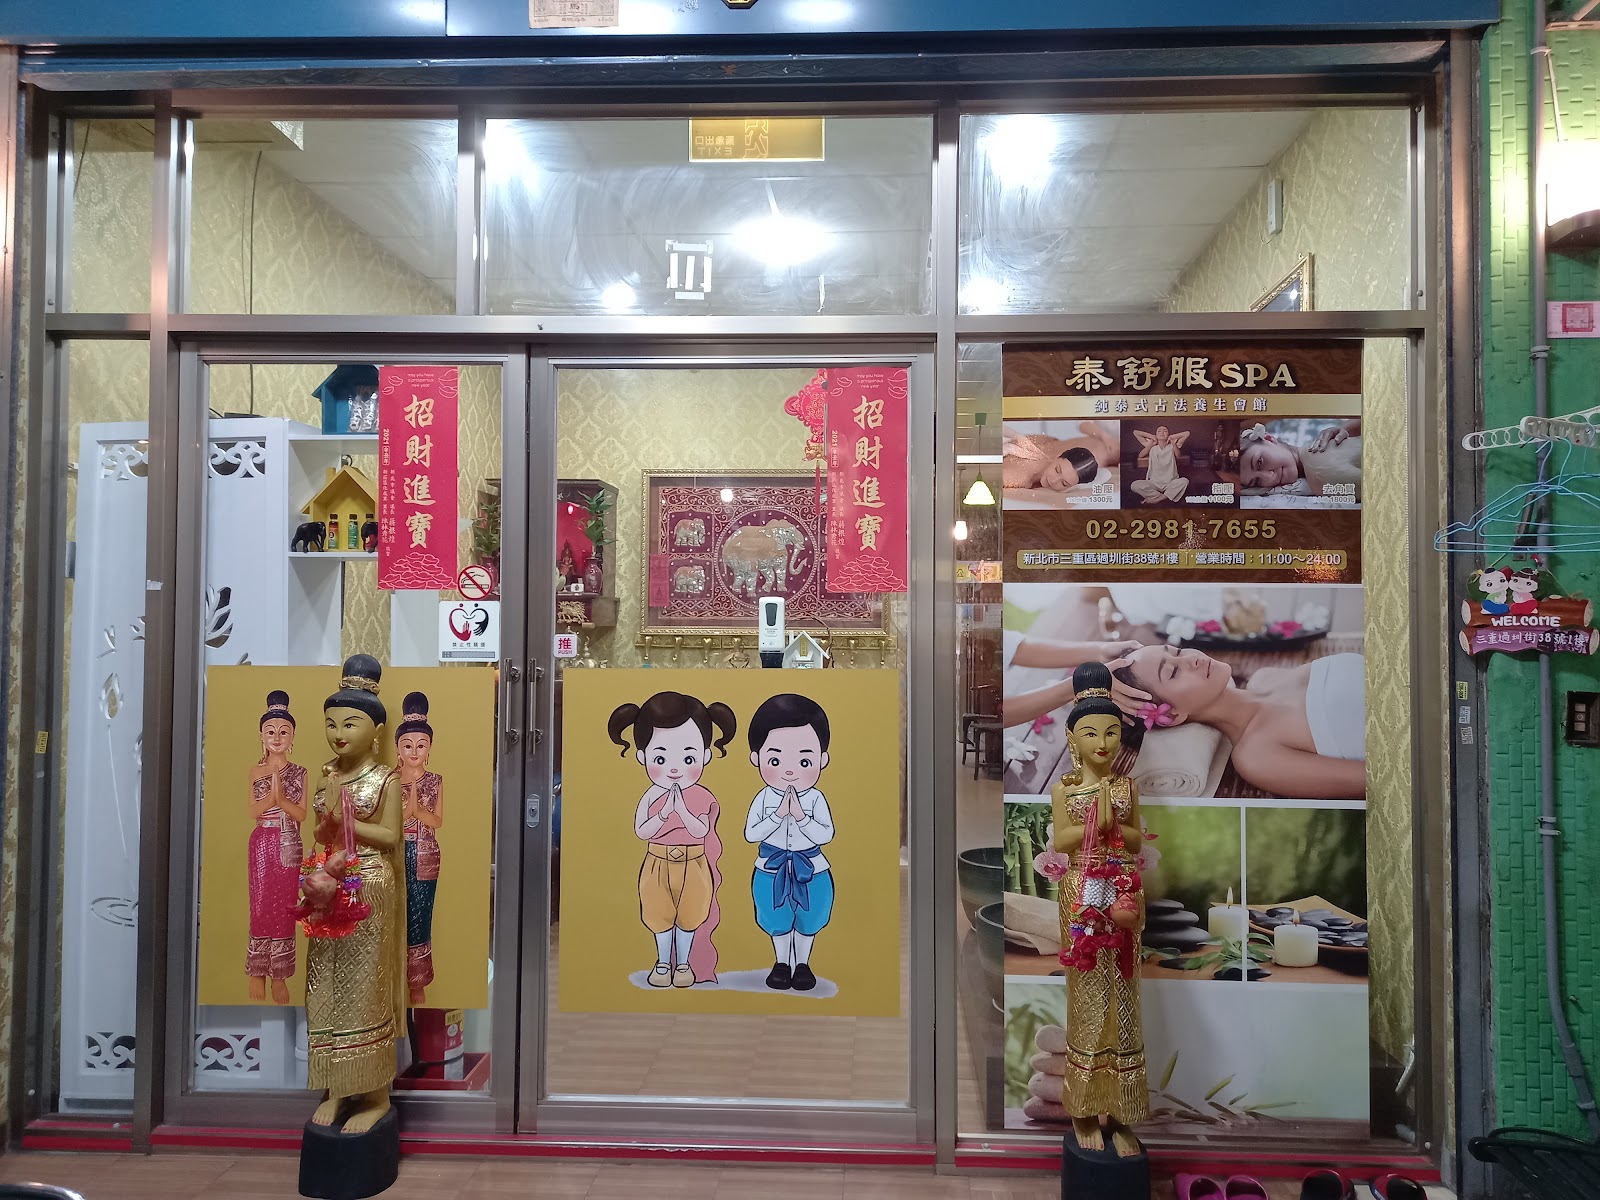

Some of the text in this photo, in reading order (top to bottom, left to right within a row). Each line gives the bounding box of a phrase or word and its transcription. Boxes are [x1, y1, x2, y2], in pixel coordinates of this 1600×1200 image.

[1094, 398, 1268, 413] 純泰式古法養生會館
[402, 394, 436, 549] 招財進寶
[852, 395, 886, 552] 招財進寶
[1092, 484, 1114, 494] 油壓
[1212, 483, 1234, 494] 指壓
[1322, 483, 1355, 494] 去角質
[1086, 519, 1276, 539] 02-2981-7655
[1023, 552, 1179, 565] 新北市三重區過圳街38號1樓
[1491, 616, 1561, 627] WELCOME
[558, 637, 572, 649] 推
